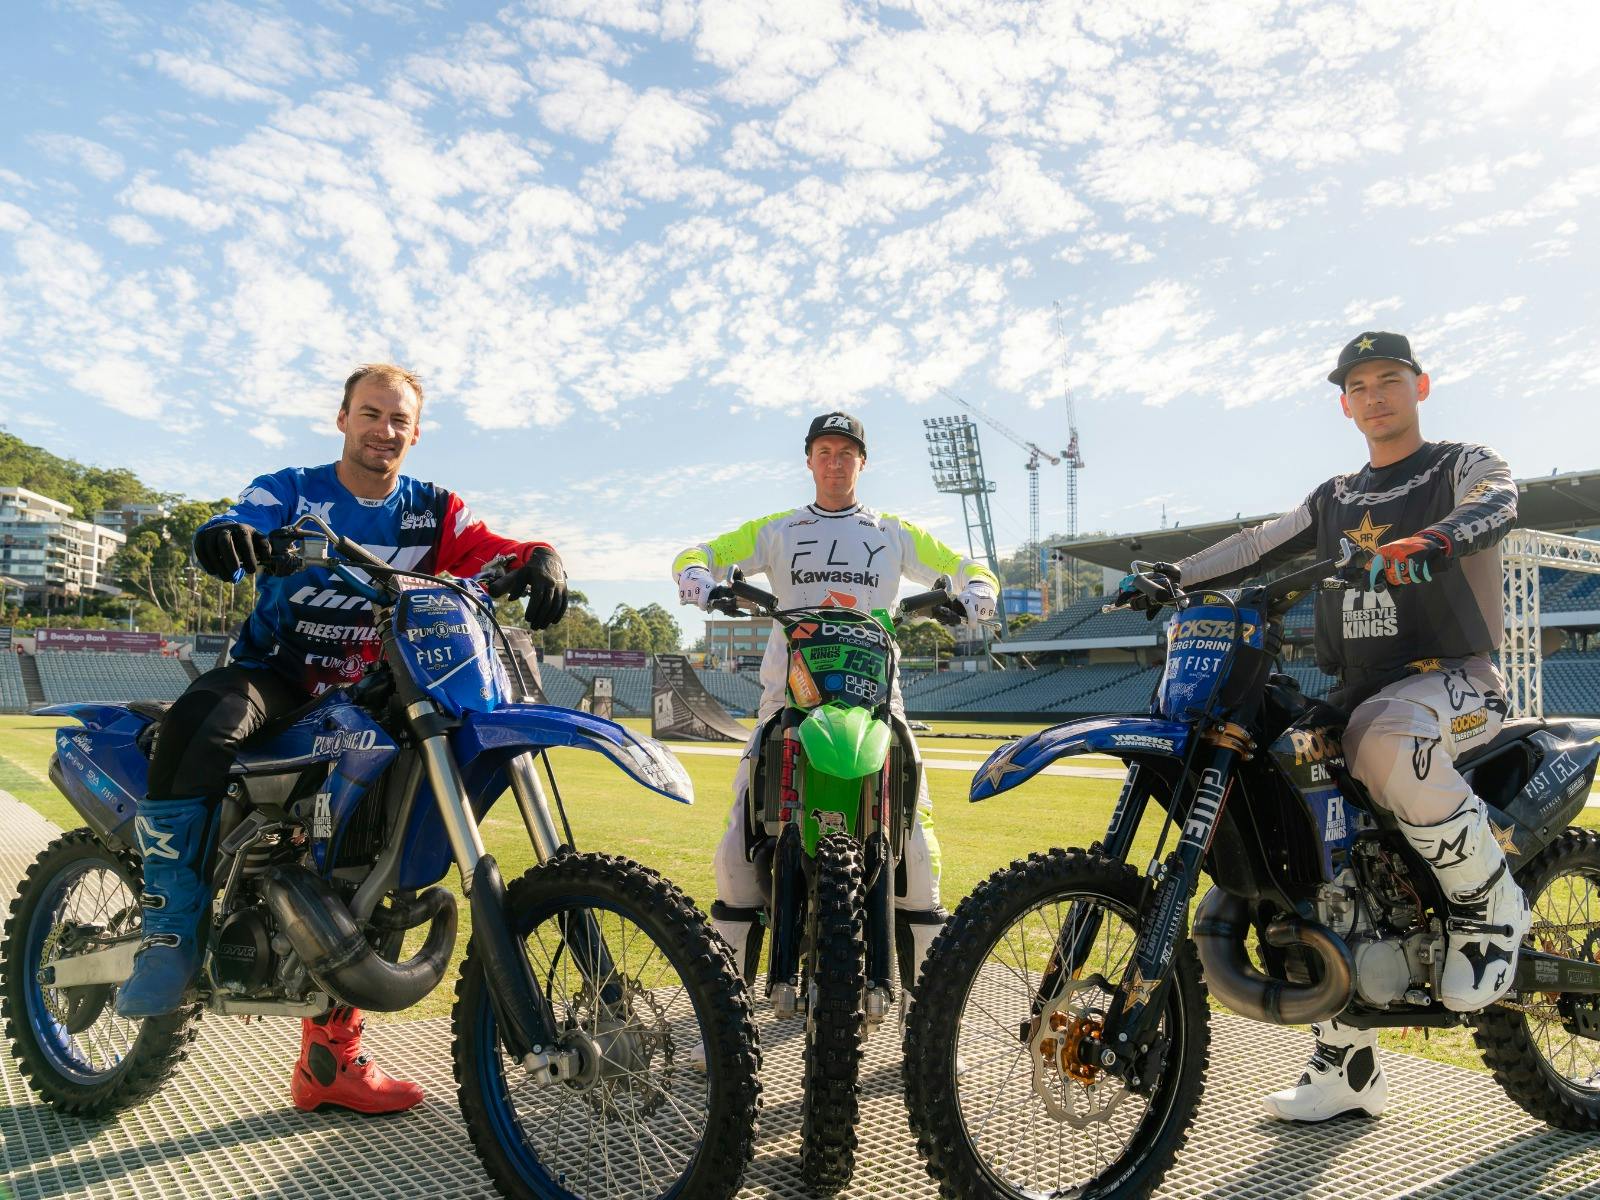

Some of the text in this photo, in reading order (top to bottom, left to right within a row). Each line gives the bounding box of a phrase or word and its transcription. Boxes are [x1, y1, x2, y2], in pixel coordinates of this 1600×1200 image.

[791, 539, 887, 568] FLY
[790, 569, 879, 588] Kawasaki
[1343, 607, 1397, 622] FREESTYLE
[50, 632, 84, 643] Bendigo
[86, 634, 107, 642] Bank
[821, 622, 887, 647] boost
[1168, 619, 1256, 643] OCKSTAR
[1343, 618, 1399, 639] KINGS
[838, 636, 872, 648] mobile
[416, 646, 452, 665] FIST
[1185, 656, 1221, 673] FIST
[845, 674, 878, 693] QUAD
[845, 683, 877, 703] LOCK
[1451, 707, 1488, 733] ROCKSTAR
[1111, 734, 1175, 747] WORKS
[1115, 741, 1174, 752] CONNECTION
[1524, 771, 1550, 799] FIST
[1145, 881, 1176, 957] EARTHWORKS
